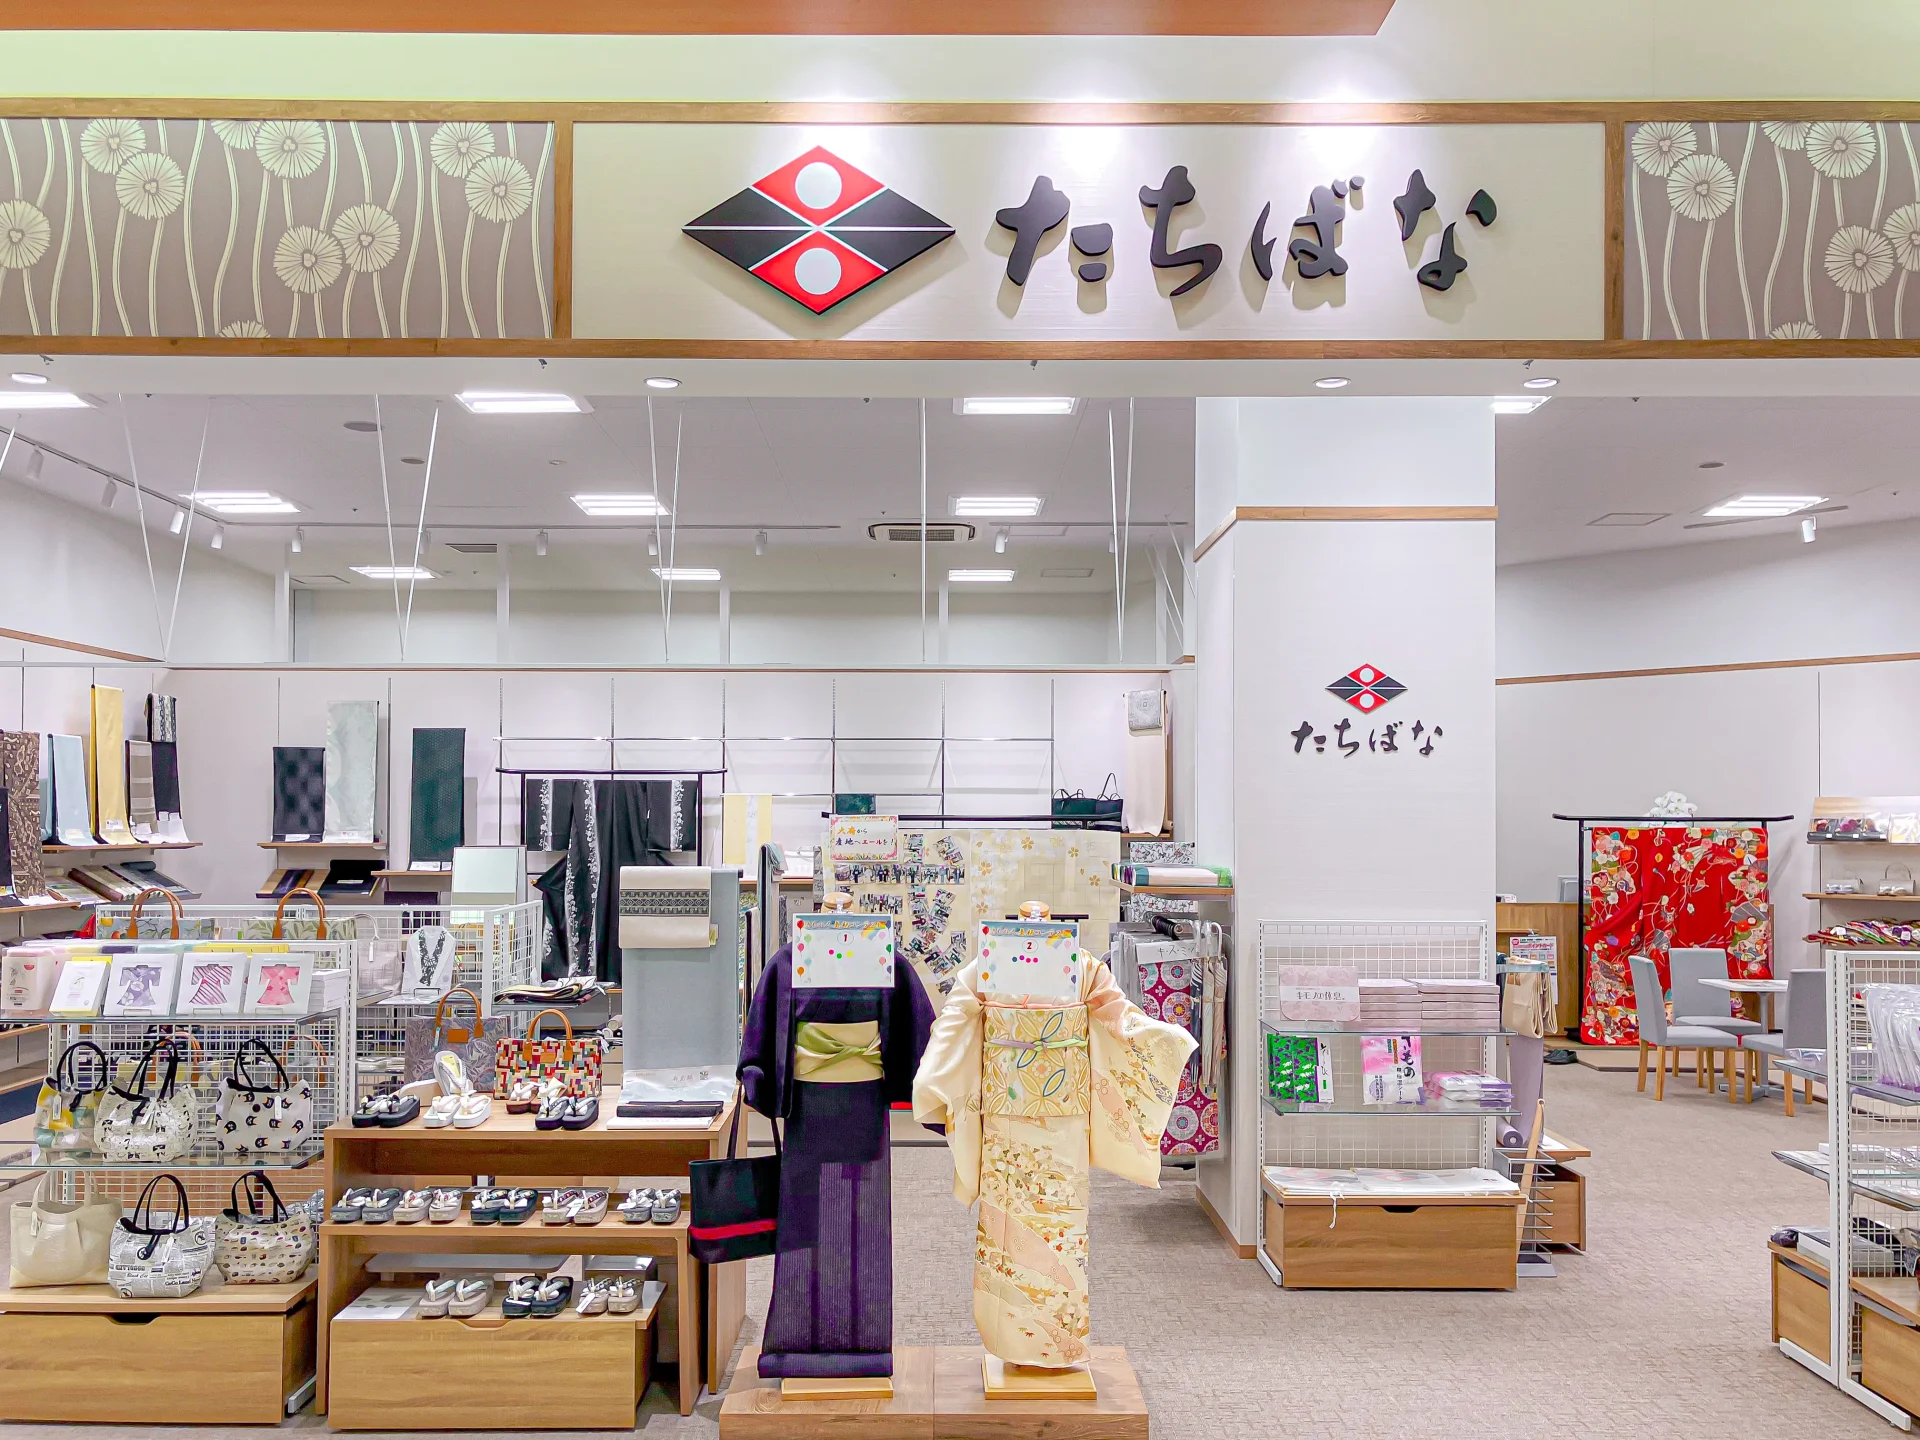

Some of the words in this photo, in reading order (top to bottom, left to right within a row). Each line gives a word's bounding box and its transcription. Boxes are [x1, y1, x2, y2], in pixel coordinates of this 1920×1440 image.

[995, 164, 1498, 298] たちばな
[1290, 718, 1443, 758] たちばな
[843, 933, 848, 943] 1
[1026, 941, 1033, 951] 2
